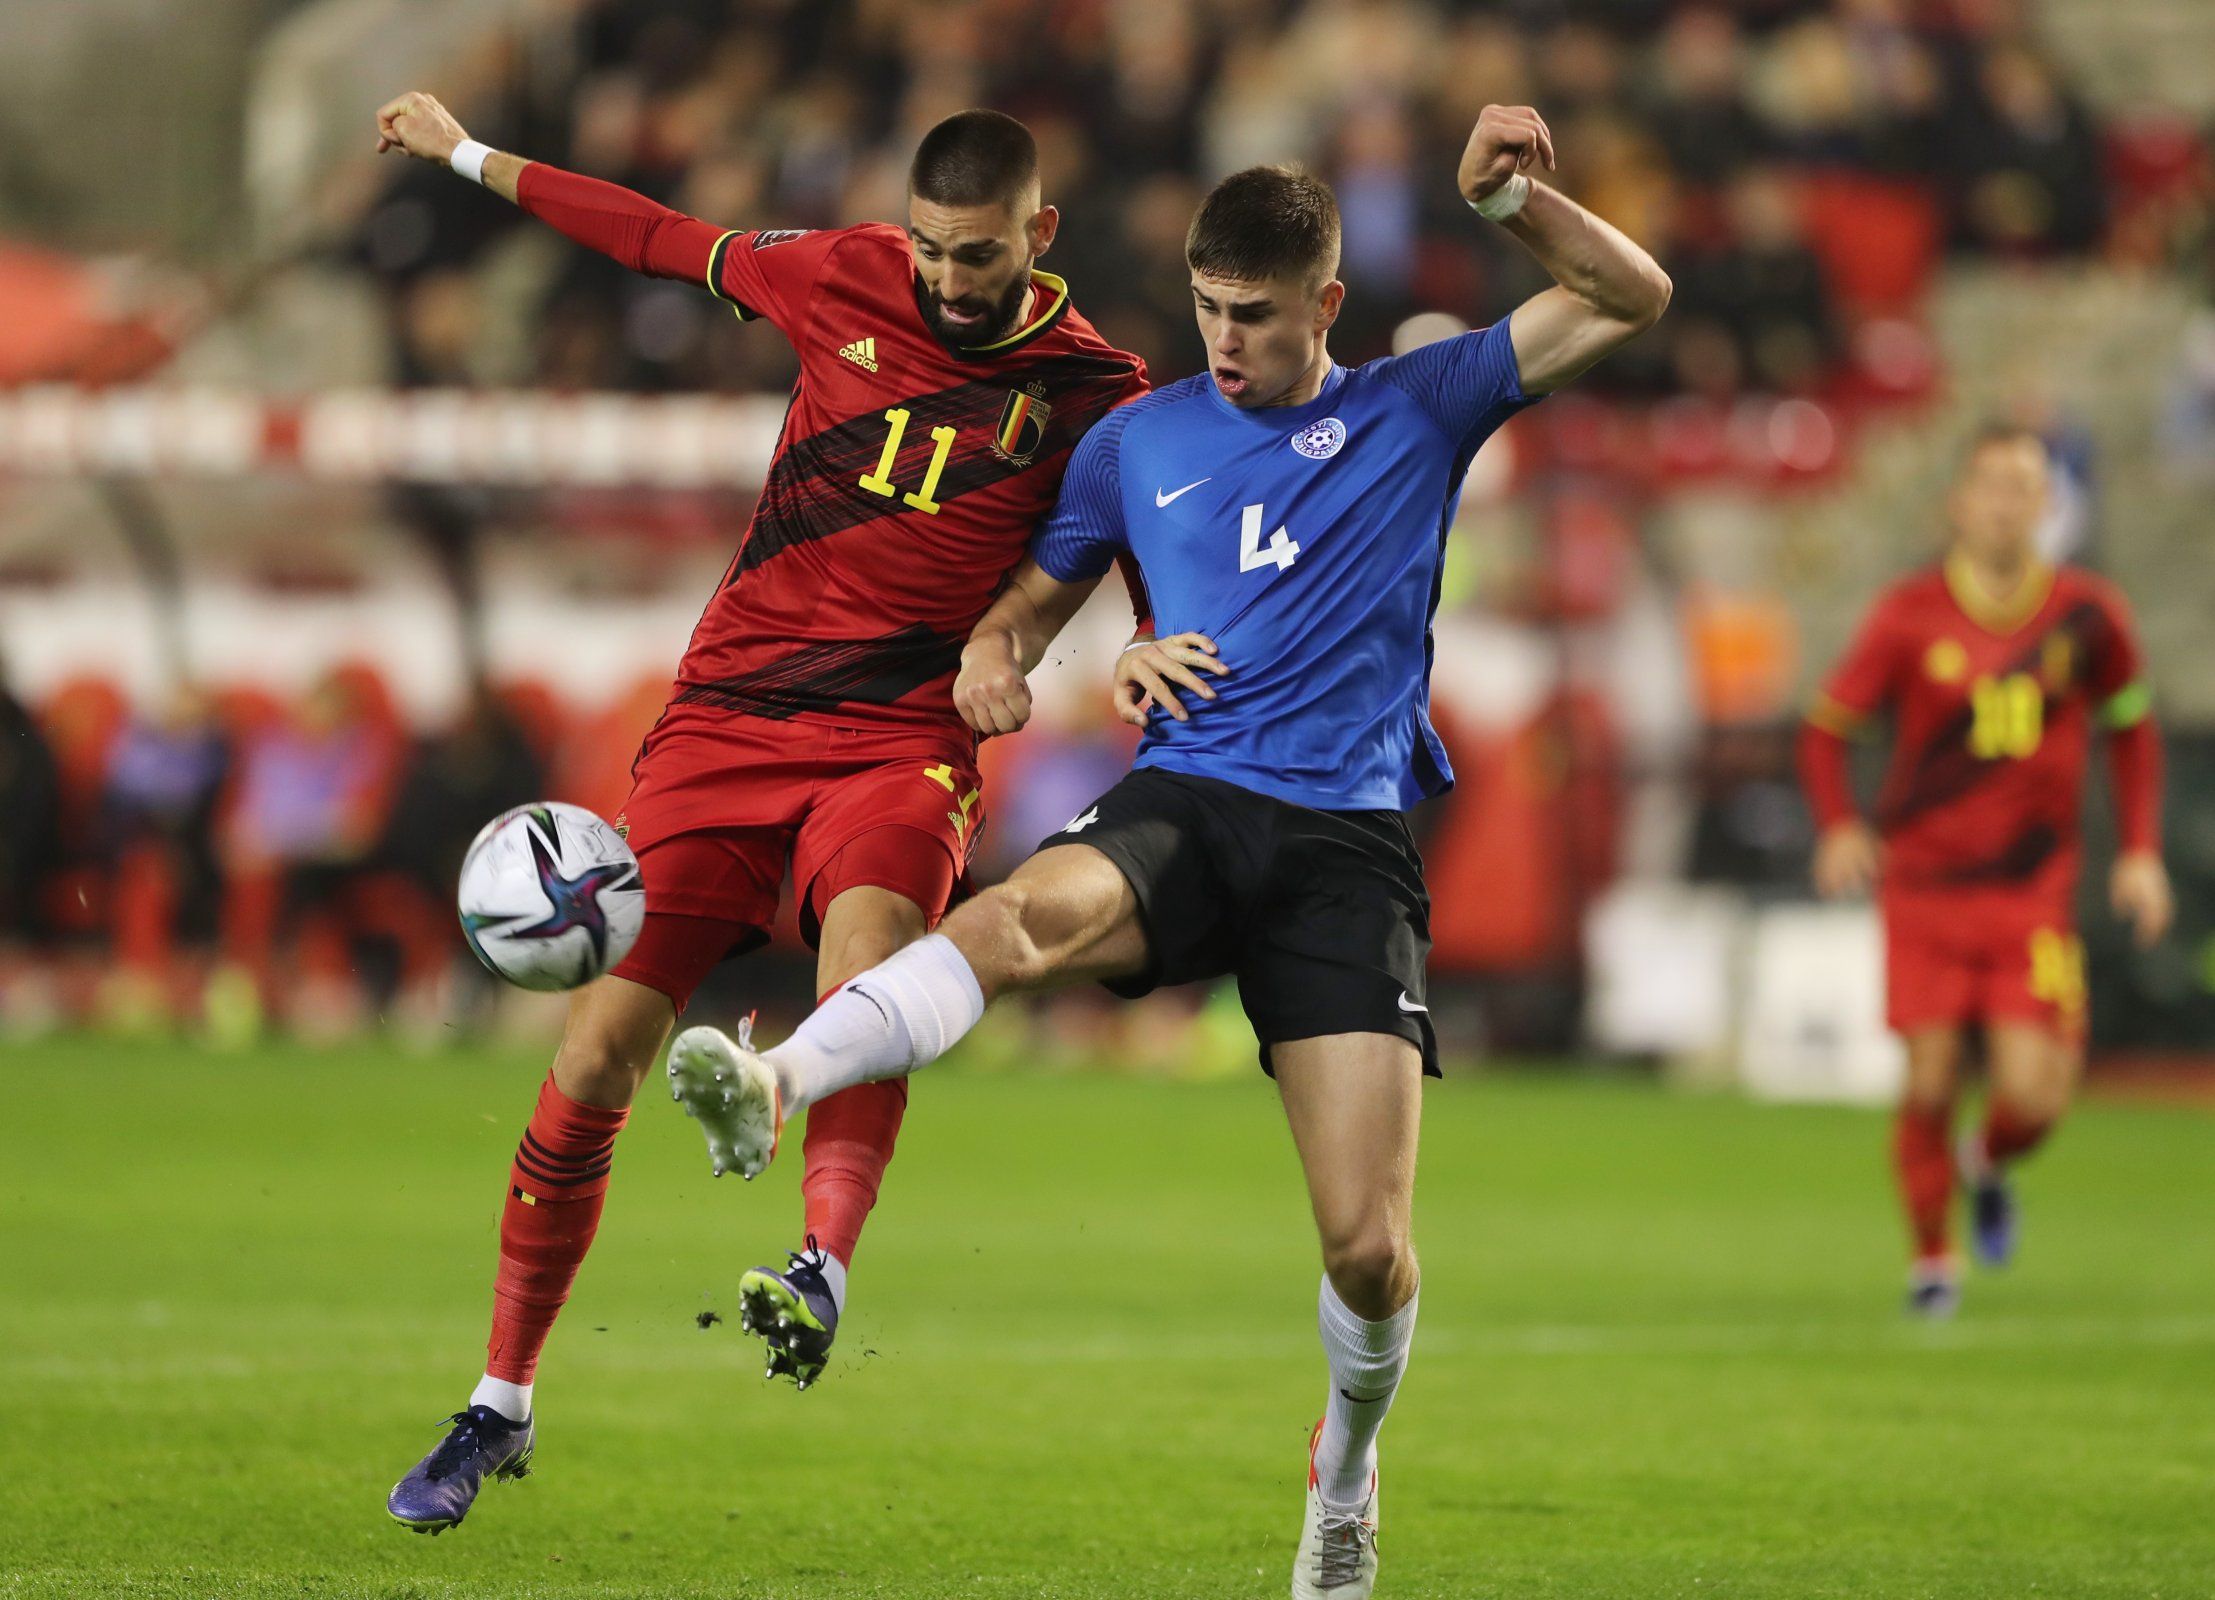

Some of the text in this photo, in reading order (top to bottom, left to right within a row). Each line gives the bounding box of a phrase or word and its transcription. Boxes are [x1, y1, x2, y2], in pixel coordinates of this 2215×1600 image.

[839, 347, 879, 373] adidas
[858, 408, 957, 516] 11
[1239, 503, 1301, 573] 4
